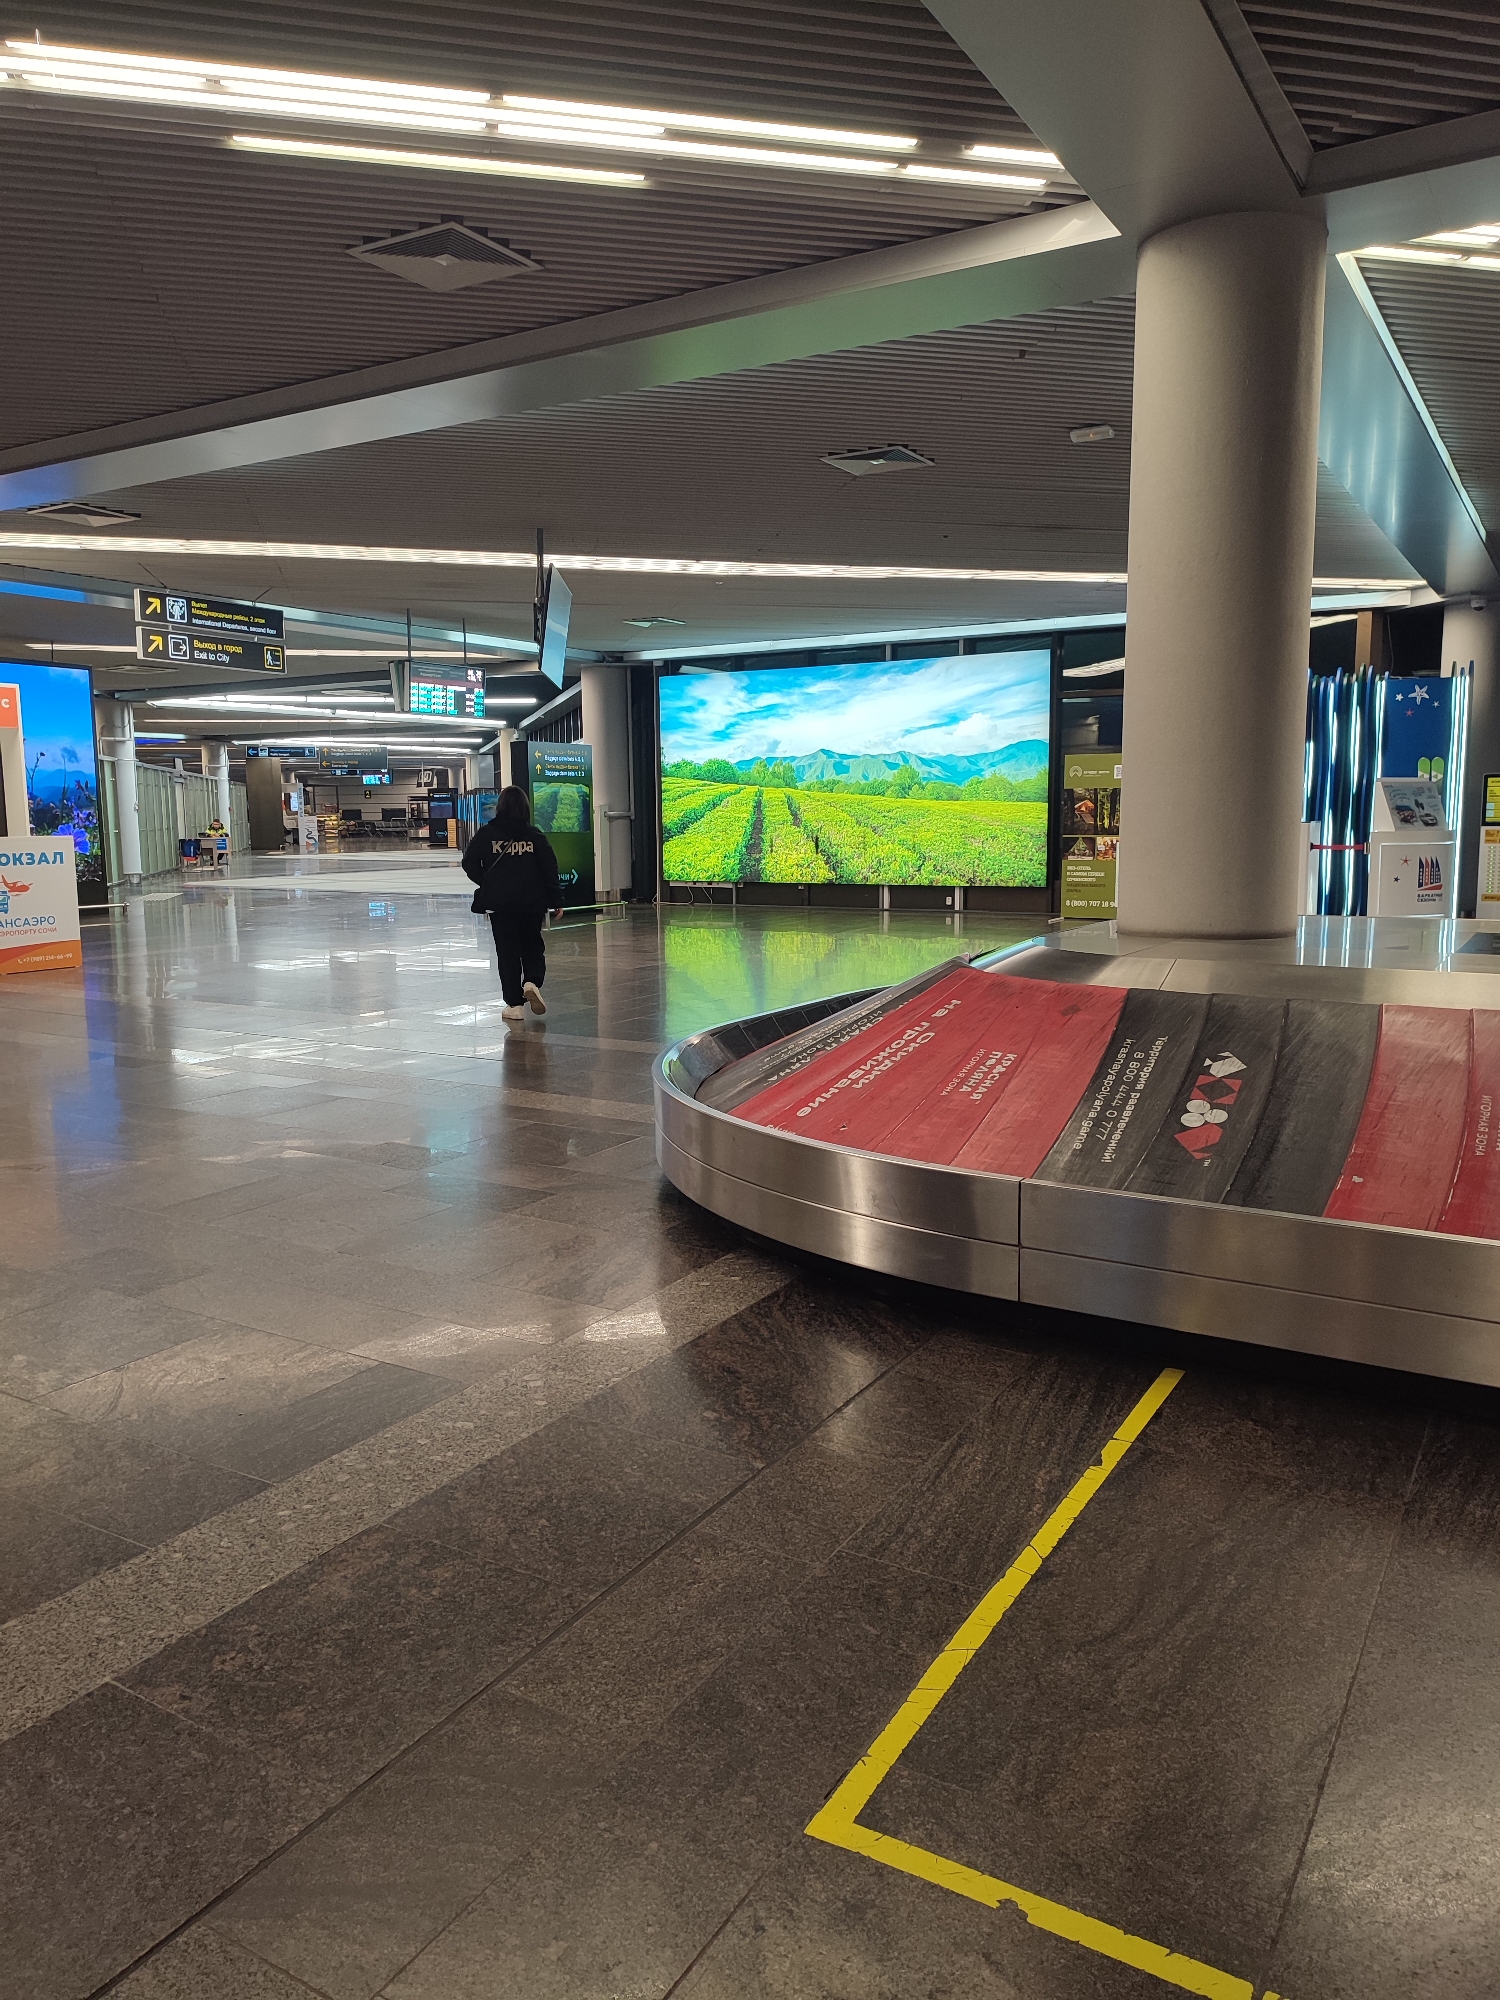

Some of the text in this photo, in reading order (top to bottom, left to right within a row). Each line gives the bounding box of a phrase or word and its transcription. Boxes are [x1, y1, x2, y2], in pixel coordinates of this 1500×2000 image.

[193, 639, 217, 651] Выход
[223, 644, 243, 654] город
[194, 650, 230, 664] Exit to City
[491, 840, 534, 856] Kappa
[1071, 900, 1088, 908] (800)
[0, 928, 37, 938] ЭРОПОРТУ
[931, 999, 962, 1019] на
[796, 1021, 931, 1117] проживание
[852, 1032, 936, 1089] Скидки
[939, 1048, 987, 1097] ИГОРНАЯ ЗОНА
[1135, 1036, 1168, 1090] Территория
[1096, 1051, 1145, 1141] 8 800 444 0 777
[1474, 1094, 1493, 1156] ИГОРНАЯ ЗОНА
